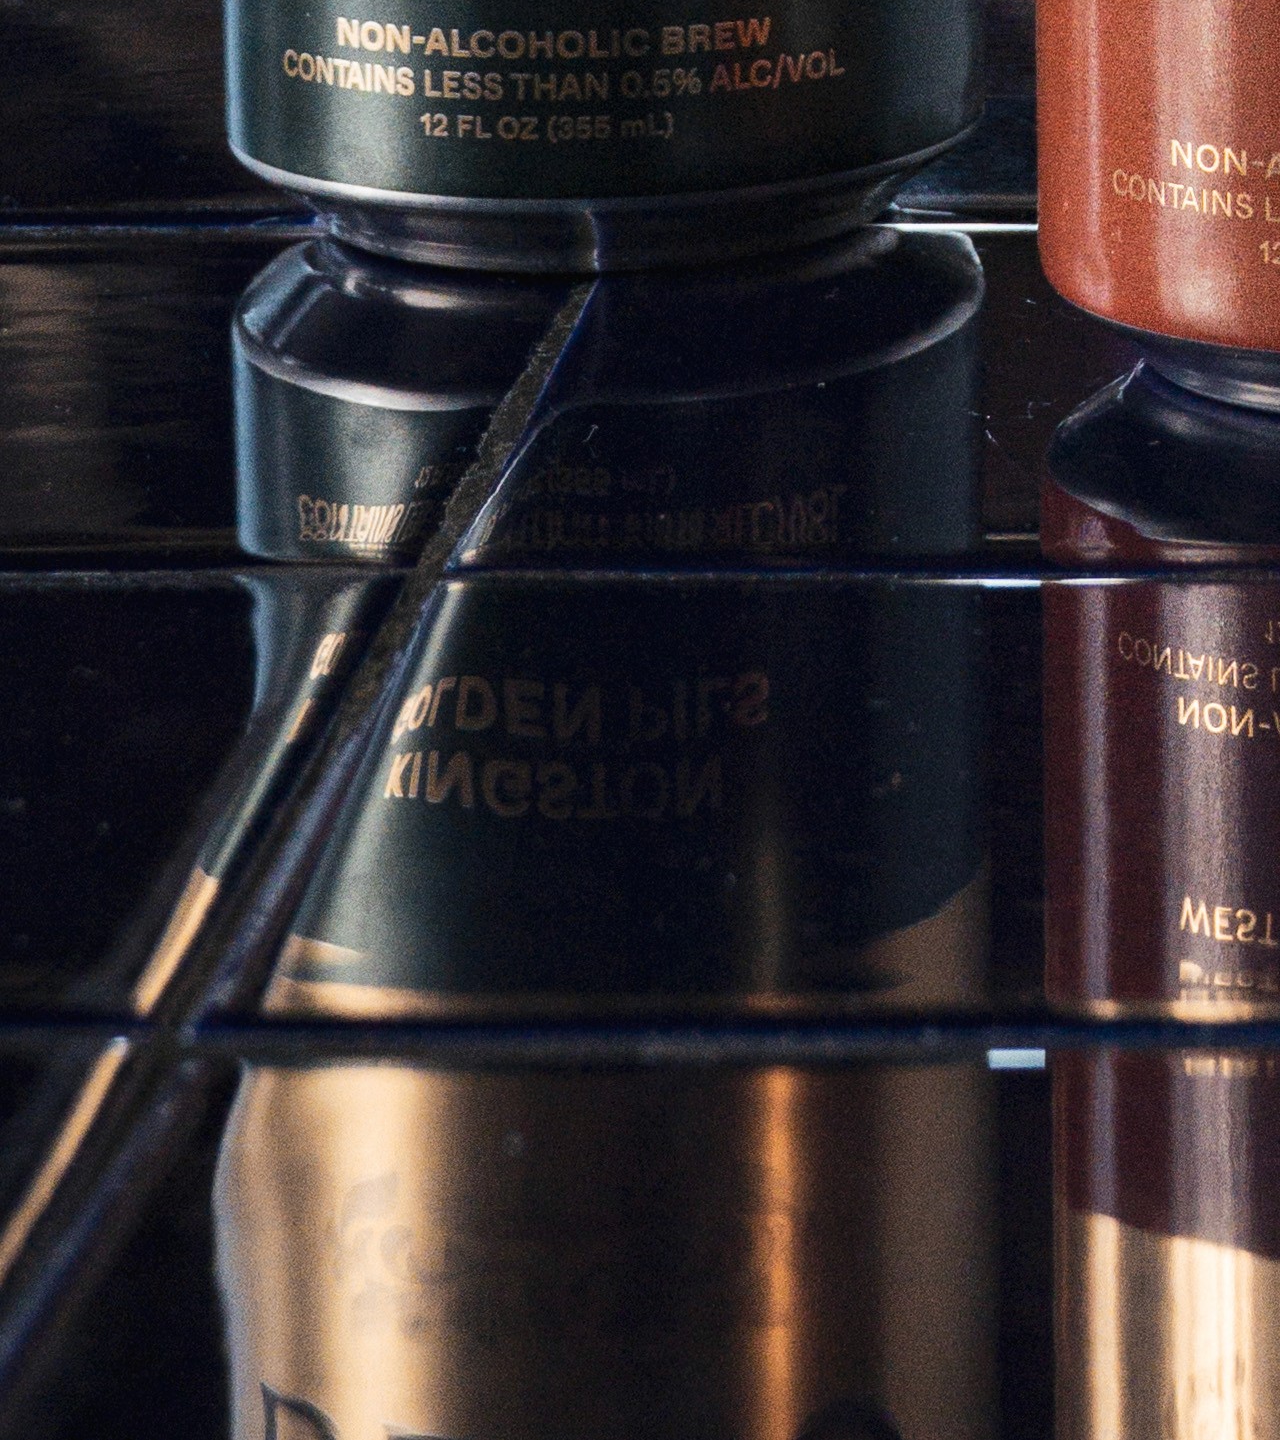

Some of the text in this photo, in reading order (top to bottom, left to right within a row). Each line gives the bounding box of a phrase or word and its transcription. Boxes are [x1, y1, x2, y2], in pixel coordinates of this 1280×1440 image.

[336, 16, 772, 60] NON-ALCOHOLIC BREW
[282, 47, 845, 101] CONTAINS LESS THAN 0.5% ALC/VOL
[420, 111, 675, 144] 12 FL OZ (355 mL)
[1111, 167, 1254, 220] CONTAINS
